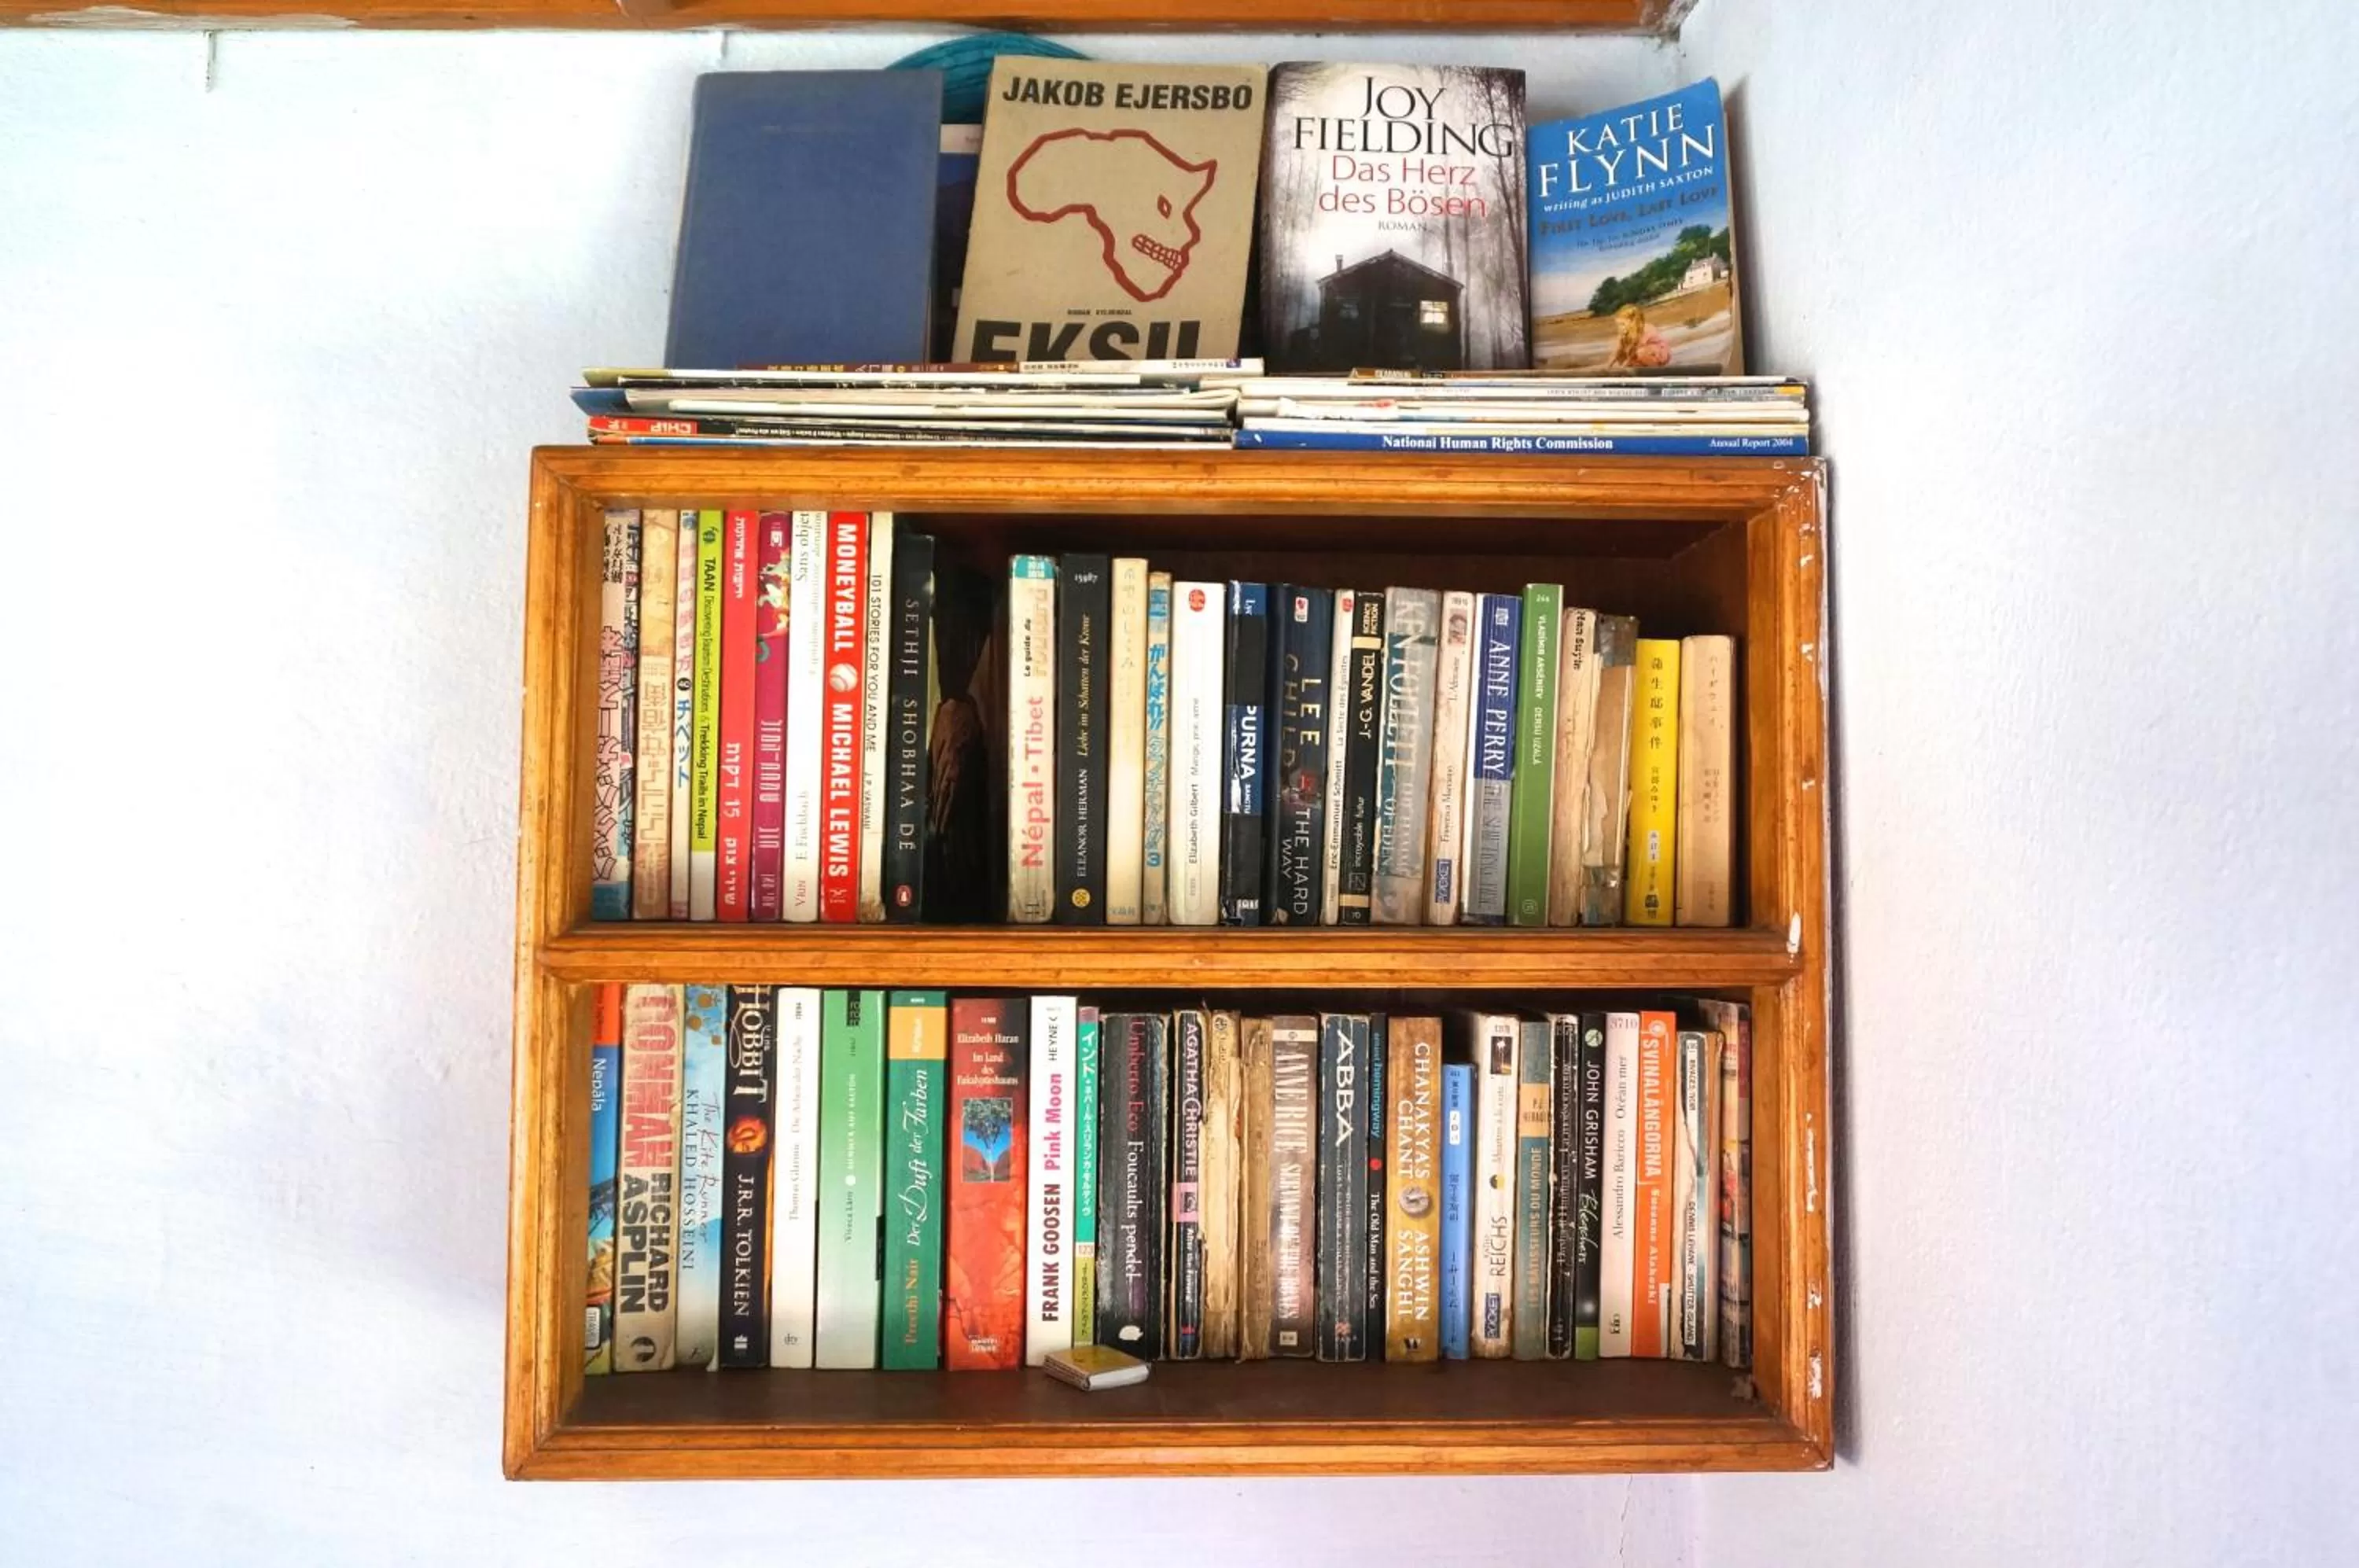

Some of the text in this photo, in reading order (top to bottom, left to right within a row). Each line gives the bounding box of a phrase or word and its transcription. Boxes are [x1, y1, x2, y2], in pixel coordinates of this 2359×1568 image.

[1003, 76, 1253, 111] JAKOB EJERSBO
[1362, 77, 1447, 122] JOY
[1294, 116, 1514, 157] FIELDING
[1539, 125, 1715, 197] FLYNN
[1568, 103, 1684, 156] KATIE
[1319, 186, 1486, 218] des Bösen
[1333, 155, 1477, 186] Das Herz
[1544, 166, 1714, 212] writing as JUDITH SAXTON
[1378, 221, 1428, 232] ROMAN
[650, 421, 692, 434] CHIP
[1383, 435, 1614, 451] National Human Rights Commission
[1709, 438, 1741, 448] Annual
[1742, 438, 1771, 449] Report
[704, 557, 716, 592] TAAN
[794, 512, 811, 582] Sans objet
[702, 594, 715, 637] Discovering
[834, 523, 858, 653] MONEYBALL
[866, 573, 882, 753] 101 STORIES FOR YOU AND ME
[900, 598, 919, 675] SETHJI
[1023, 635, 1032, 663] guide
[1077, 648, 1090, 665] der
[1573, 610, 1586, 671] Han Suyin
[1282, 653, 1298, 768] CHILD
[1360, 652, 1375, 704] VANDEL
[1483, 639, 1511, 775] ANNE PERRY
[1300, 679, 1321, 746] LEE
[697, 724, 709, 767] Trekking
[900, 698, 918, 808] SHOBHAA
[697, 771, 708, 796] Trails
[697, 797, 708, 807] in
[719, 742, 741, 818] 15 דקות
[829, 704, 854, 878] MICHAEL LEWIS
[1021, 696, 1051, 868] Népal Tibet
[1333, 760, 1342, 797] Schmitt
[695, 808, 708, 840] Nepal
[1076, 768, 1088, 878] ELEANOR HERMAN
[1189, 784, 1199, 864] Elizabeth Gilbert
[1282, 838, 1292, 879] WAY
[1293, 808, 1311, 915] THE HARD
[1437, 859, 1450, 903] POCKET
[731, 985, 771, 1104] HOBBIT
[1048, 1025, 1058, 1062] HEYNE
[591, 1058, 607, 1111] Nepāla
[701, 1091, 721, 1124] The
[903, 1069, 929, 1134] Farben
[1182, 1023, 1202, 1176] AGATHA CHRISTIE
[1274, 1051, 1309, 1154] ANNE RICE
[1335, 1029, 1355, 1147] ABBA
[1371, 1062, 1383, 1139] hemingway
[1415, 1042, 1431, 1179] CHANAKYA'S
[1614, 1055, 1628, 1120] Océan mer
[697, 1128, 720, 1169] Kite
[908, 1132, 923, 1154] der
[1043, 1073, 1062, 1171] Pink Moon
[1121, 1019, 1146, 1278] Umberto Eco Foucaults pendel
[1397, 1100, 1414, 1179] CHANT
[682, 1088, 699, 1270] KHALED HOSSEINI
[898, 1158, 932, 1222] Duft
[1529, 1147, 1542, 1209] DU MONDE
[1578, 1060, 1600, 1264] JOHN GRISHAM Bleachers
[1612, 1129, 1625, 1240] Alessandro Baricco
[620, 1172, 650, 1313] ASPLIN
[648, 1172, 672, 1312] RICHARD
[734, 1173, 754, 1317] J.R.R. TOLKIEN
[906, 1222, 921, 1246] Der
[1042, 1183, 1061, 1322] FRANK GOOSEN
[1369, 1191, 1380, 1309] The Old Man and the Sea
[1490, 1216, 1507, 1277] REICHS
[904, 1258, 919, 1290] Nair
[1397, 1230, 1414, 1316] SANGHI
[1414, 1230, 1430, 1322] ASHWIN
